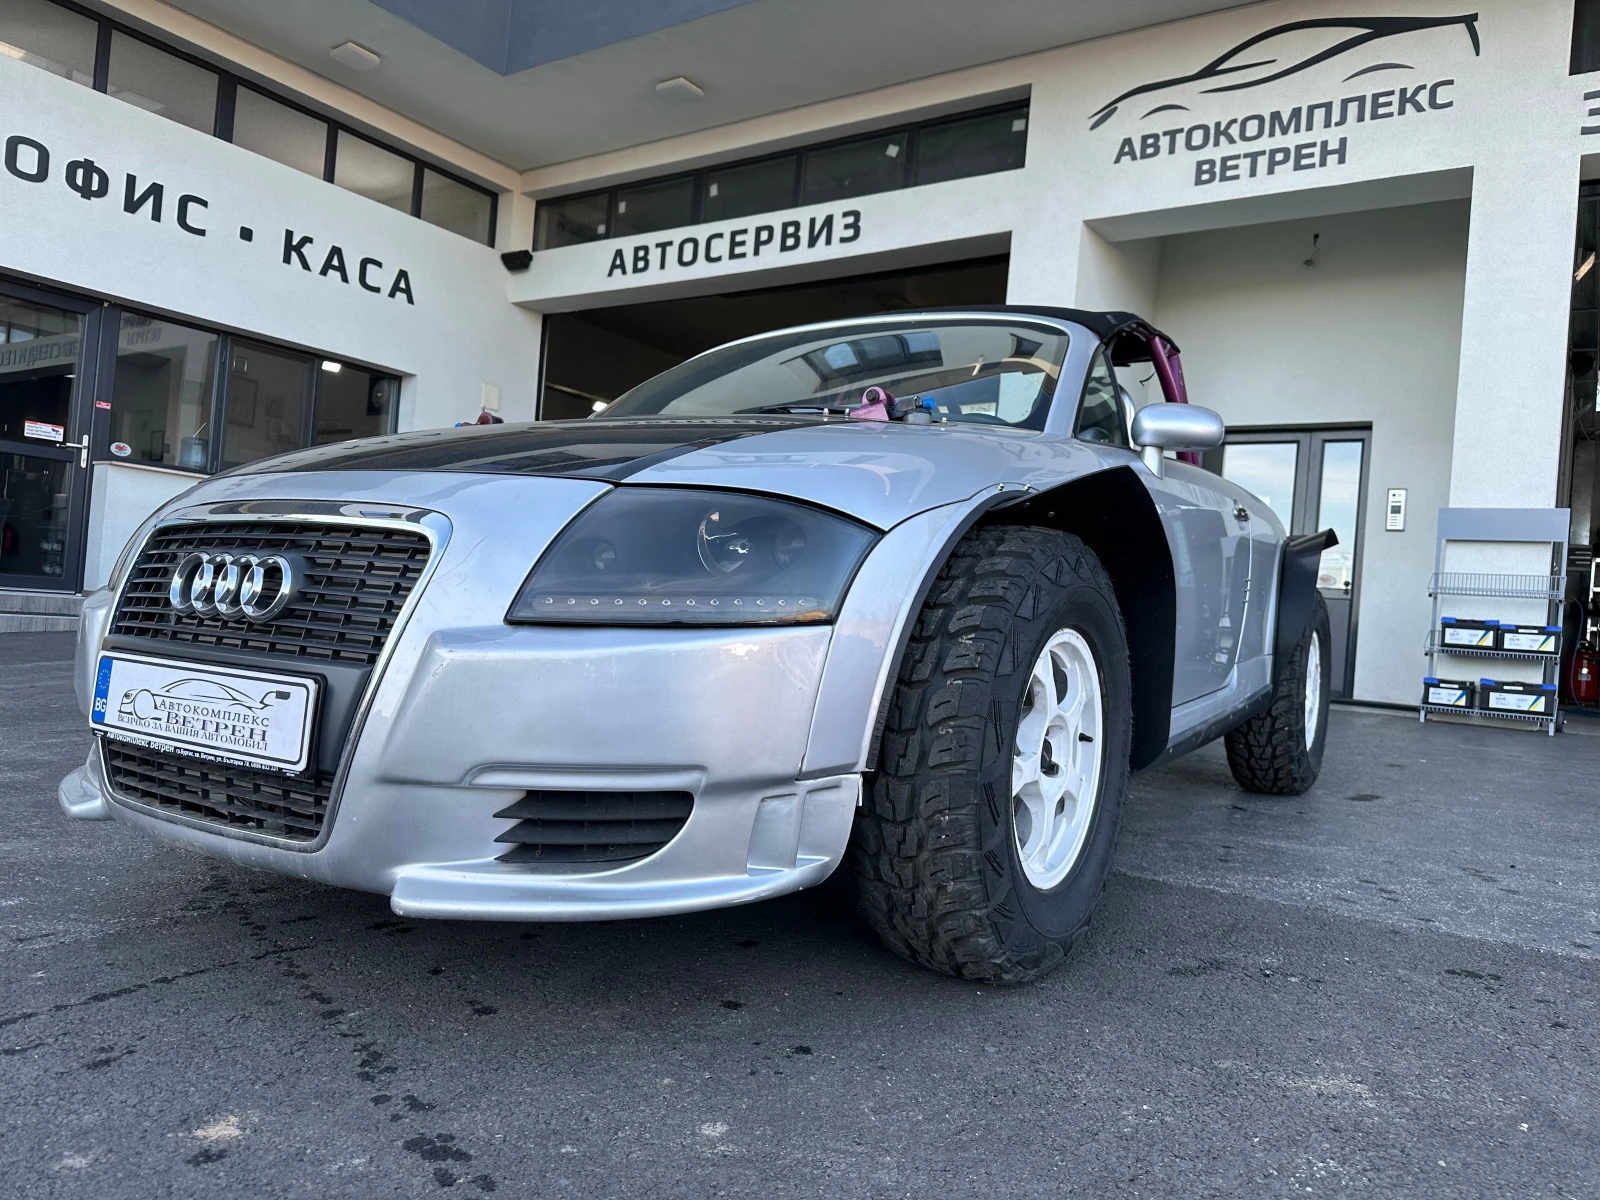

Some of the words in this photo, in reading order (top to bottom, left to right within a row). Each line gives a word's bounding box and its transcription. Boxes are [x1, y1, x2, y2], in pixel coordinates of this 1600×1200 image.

[1113, 78, 1455, 165] АВТОКОМПЛЕКС
[1194, 137, 1348, 187] ВЕТРЕН
[4, 134, 210, 238] ОФИС
[282, 228, 417, 306] КАСА
[606, 209, 863, 278] АВТОСЕРВИЗ
[94, 697, 107, 713] BG
[159, 699, 270, 727] АВТОКОМПЛЕКС
[117, 713, 150, 728] ВСИЧКО
[151, 720, 163, 731] ЗА
[165, 723, 199, 738] ВАШИЯ
[201, 731, 268, 751] АВТОМОБИЛ
[165, 710, 268, 742] ВЕТРЕН
[150, 740, 175, 753] Ветрен
